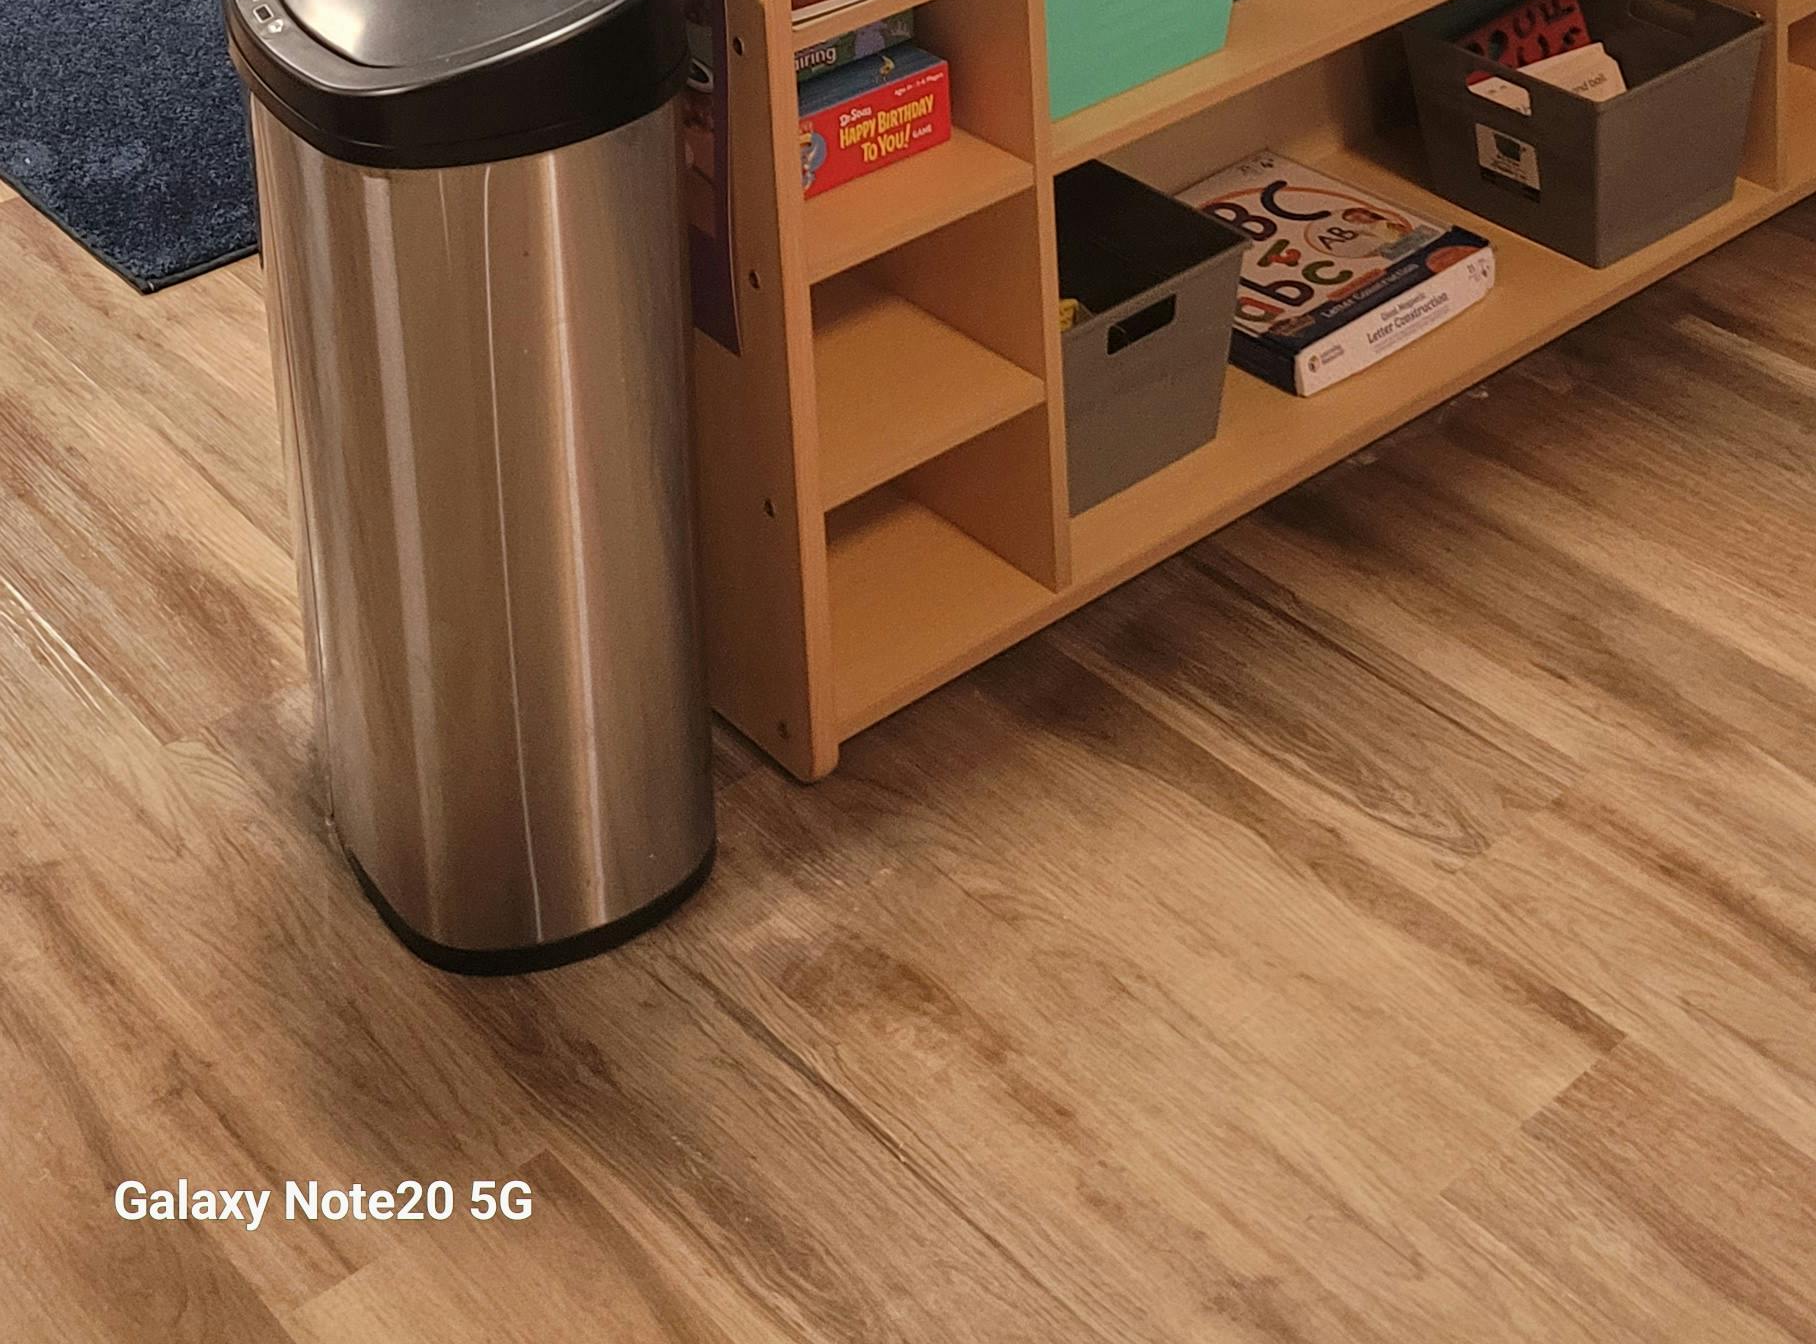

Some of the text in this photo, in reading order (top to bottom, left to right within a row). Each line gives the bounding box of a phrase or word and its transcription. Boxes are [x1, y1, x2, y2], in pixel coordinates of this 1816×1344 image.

[839, 94, 934, 149] HAPPY BIRTHDAY
[877, 123, 911, 156] YOU!
[1366, 322, 1394, 345] Letter
[1394, 291, 1449, 329] Construction
